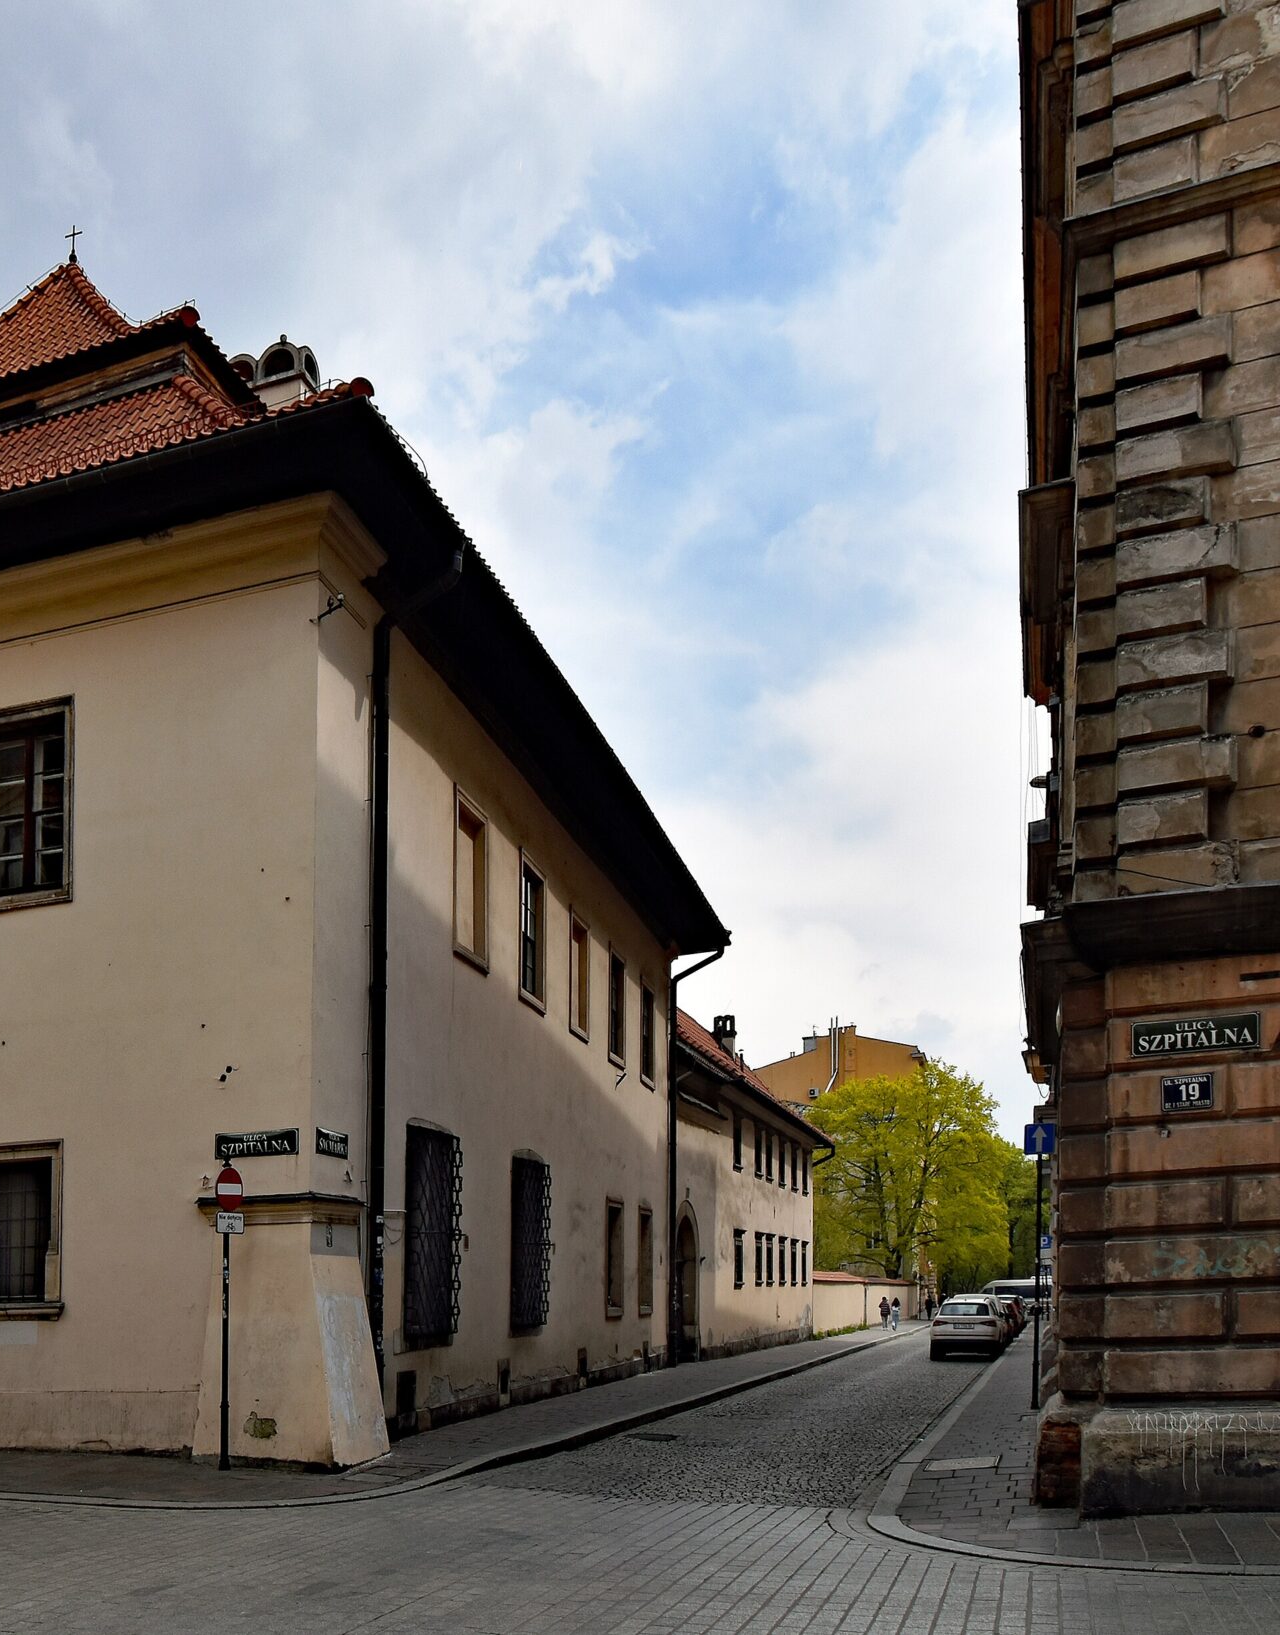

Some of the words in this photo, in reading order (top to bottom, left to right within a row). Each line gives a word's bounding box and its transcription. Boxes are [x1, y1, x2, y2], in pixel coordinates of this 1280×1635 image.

[1175, 1021, 1215, 1032] ULICA
[1138, 1027, 1253, 1052] SZPITALNA
[1174, 1076, 1208, 1085] SZPITALNA
[1179, 1083, 1200, 1101] 19
[221, 1140, 291, 1156] SZPITALNA
